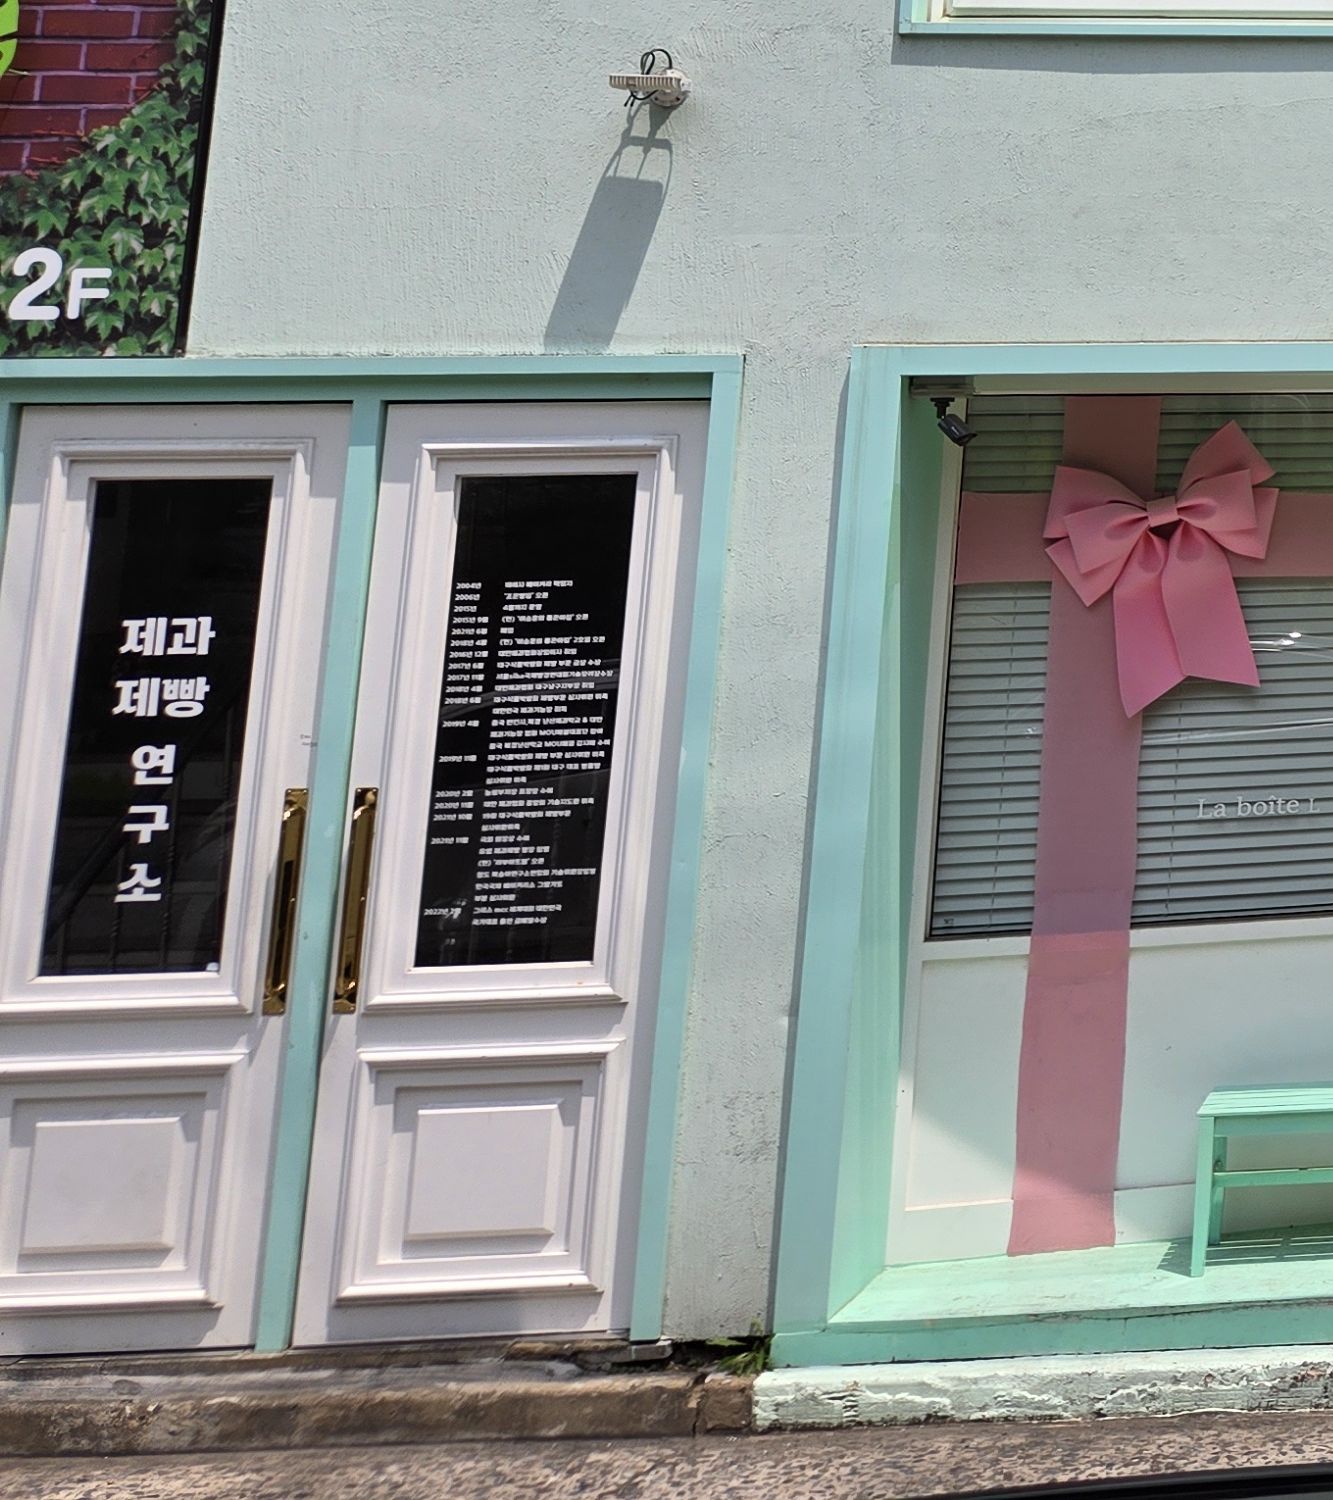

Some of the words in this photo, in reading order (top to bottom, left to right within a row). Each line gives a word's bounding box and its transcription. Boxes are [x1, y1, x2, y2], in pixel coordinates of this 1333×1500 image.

[8, 247, 113, 321] 2F
[118, 616, 217, 656] 제과
[111, 676, 211, 718] 제빵
[1196, 798, 1227, 819] La
[1236, 794, 1300, 817] boîte
[1308, 797, 1321, 813] L
